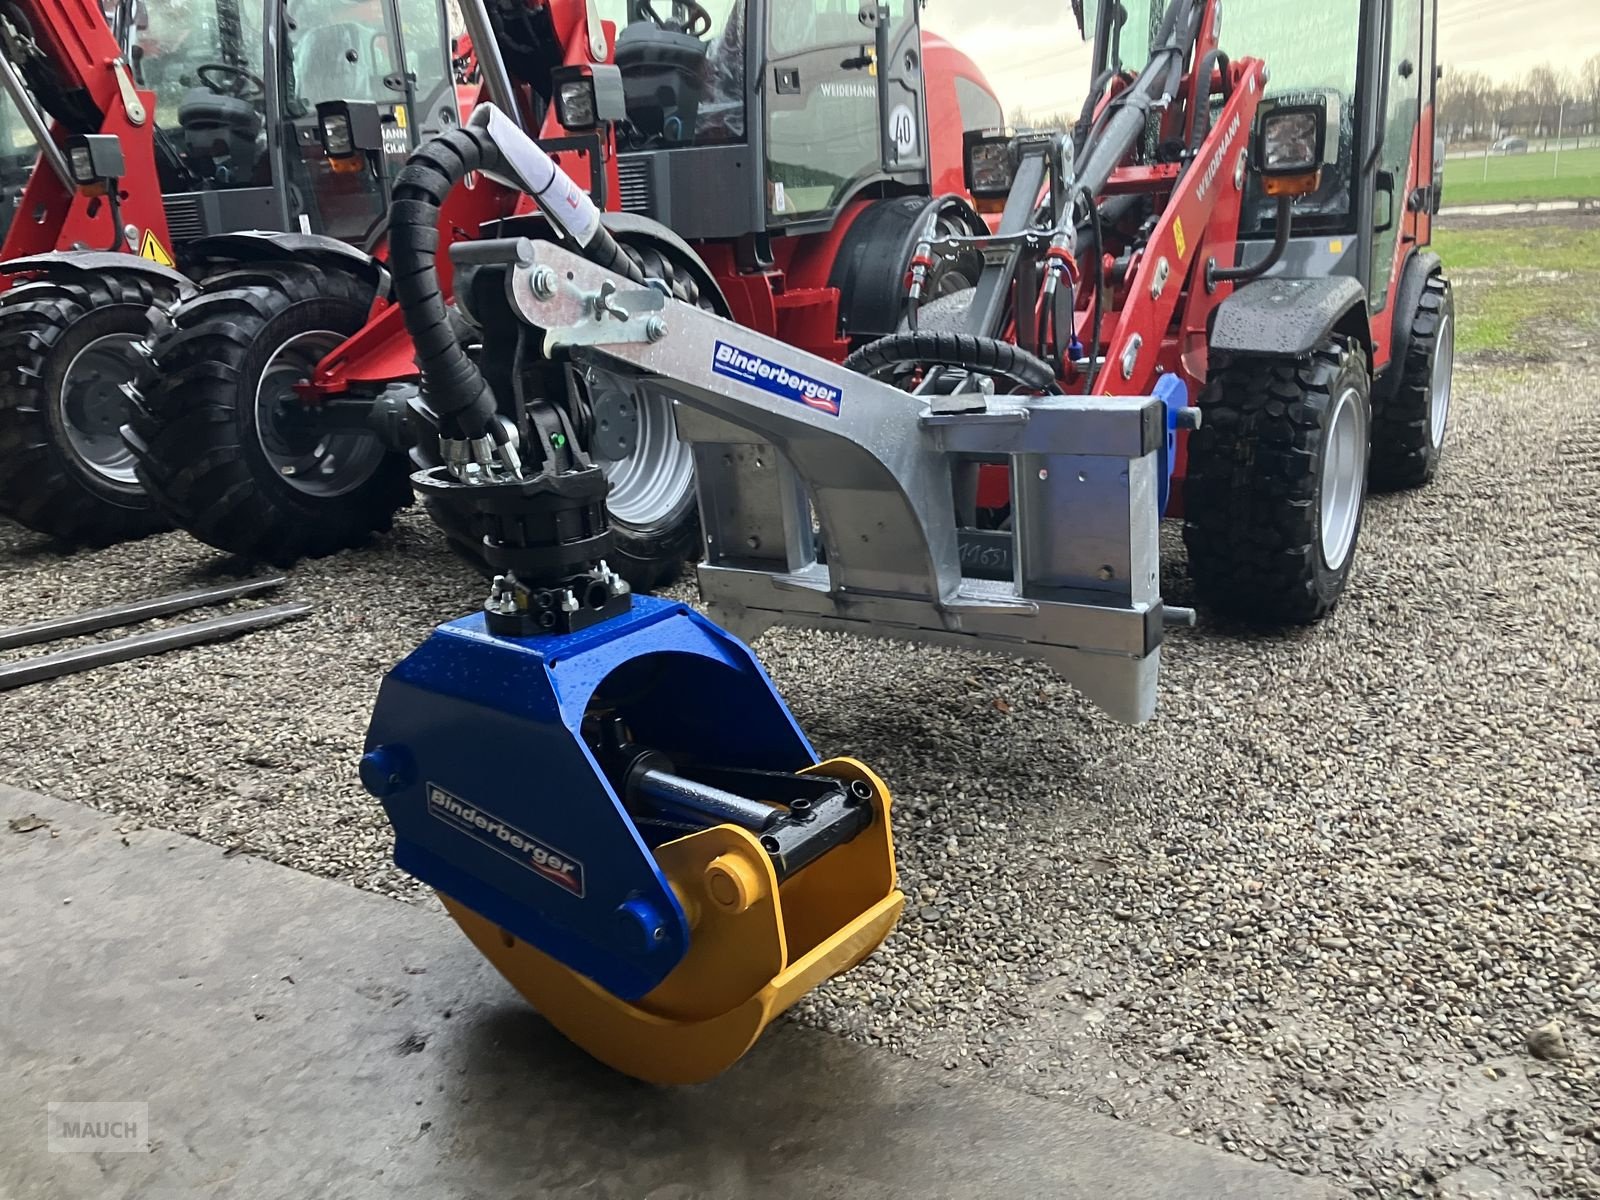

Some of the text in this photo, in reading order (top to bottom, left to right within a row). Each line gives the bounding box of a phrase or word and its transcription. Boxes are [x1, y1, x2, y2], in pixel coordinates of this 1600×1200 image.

[820, 83, 876, 98] WEIDEMANN
[895, 115, 910, 143] 40
[1196, 111, 1240, 201] WEIDEMANN
[715, 343, 837, 401] Binderberger
[431, 788, 575, 874] Binderberger
